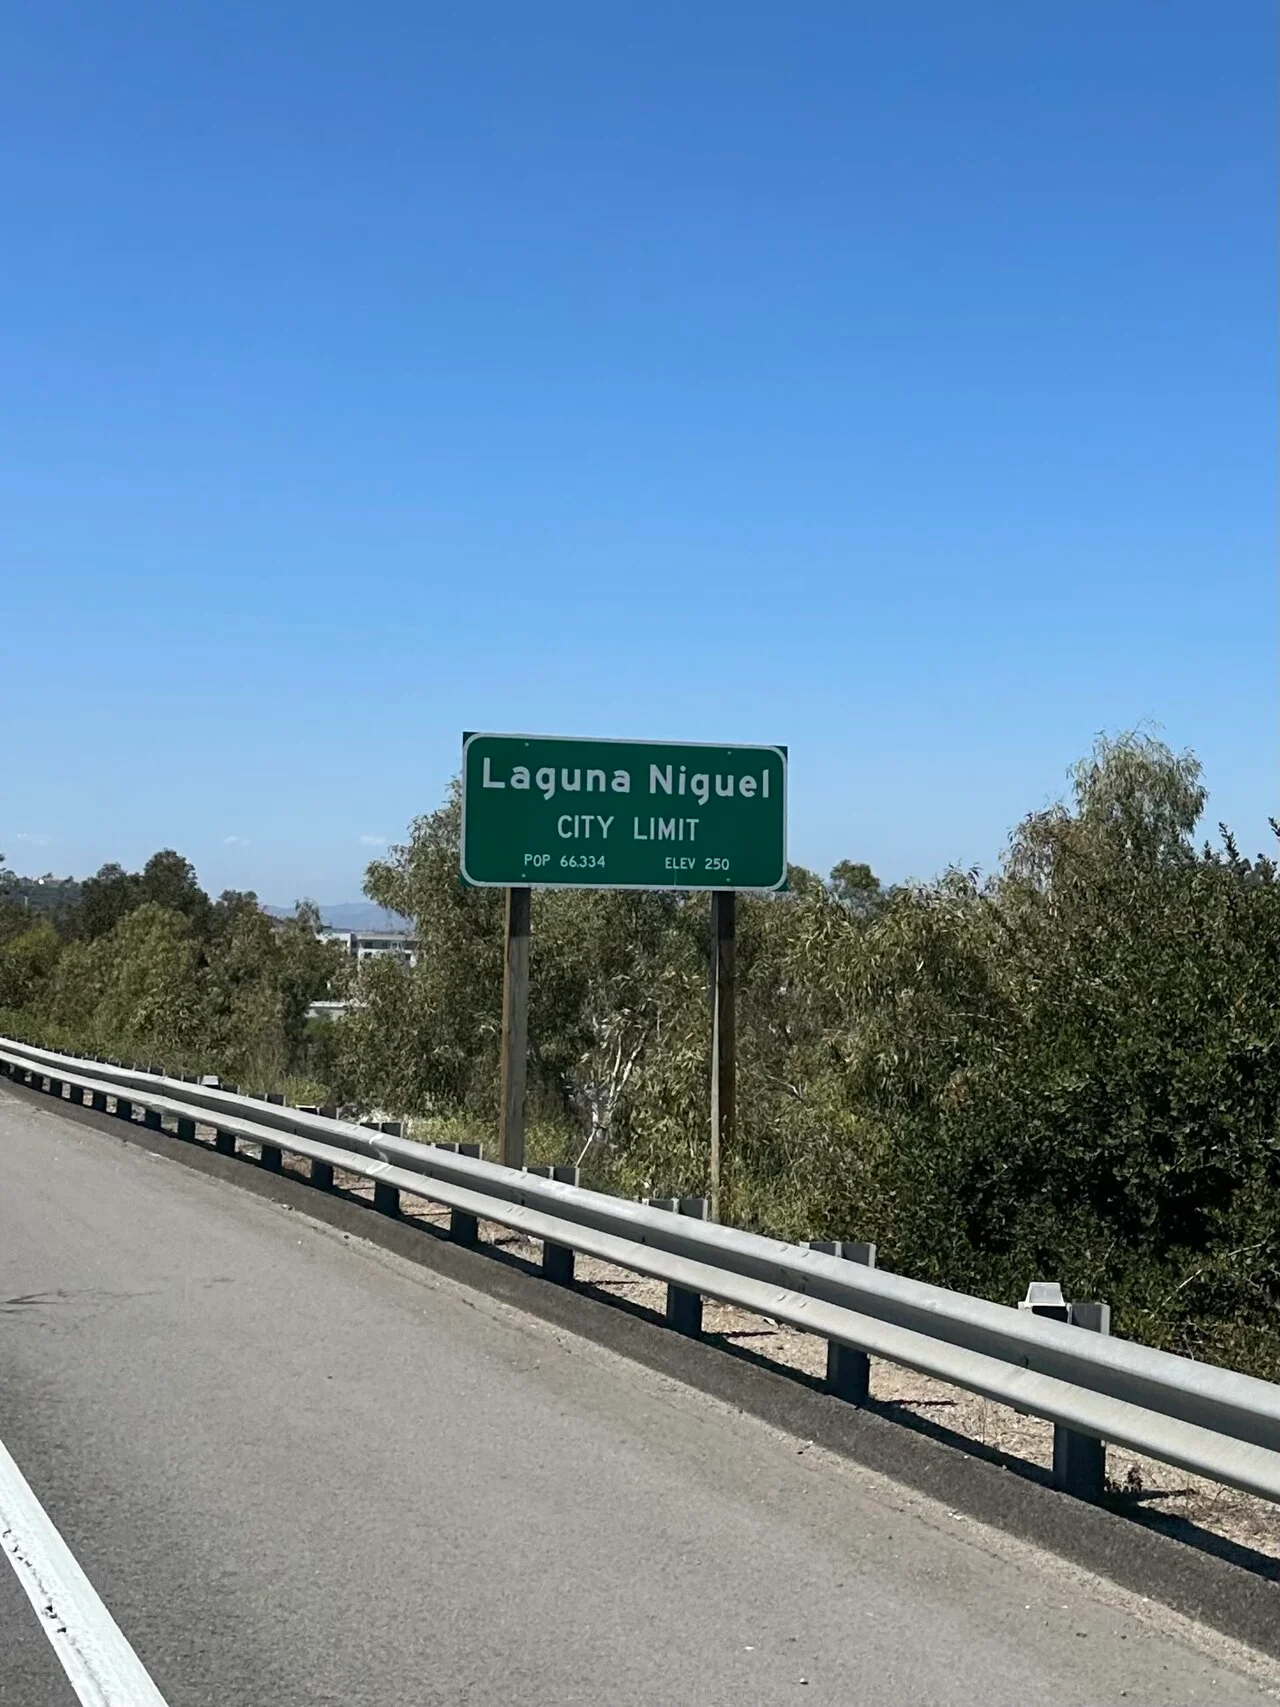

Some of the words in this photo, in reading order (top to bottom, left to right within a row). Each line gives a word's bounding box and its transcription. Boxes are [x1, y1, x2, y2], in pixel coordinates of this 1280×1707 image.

[482, 757, 631, 801] Laguna
[649, 764, 771, 805] Niguel
[557, 814, 614, 839] CITY
[633, 817, 700, 841] LIMIT
[524, 853, 551, 867] POP
[665, 857, 696, 870] ELEV
[704, 858, 730, 871] 250
